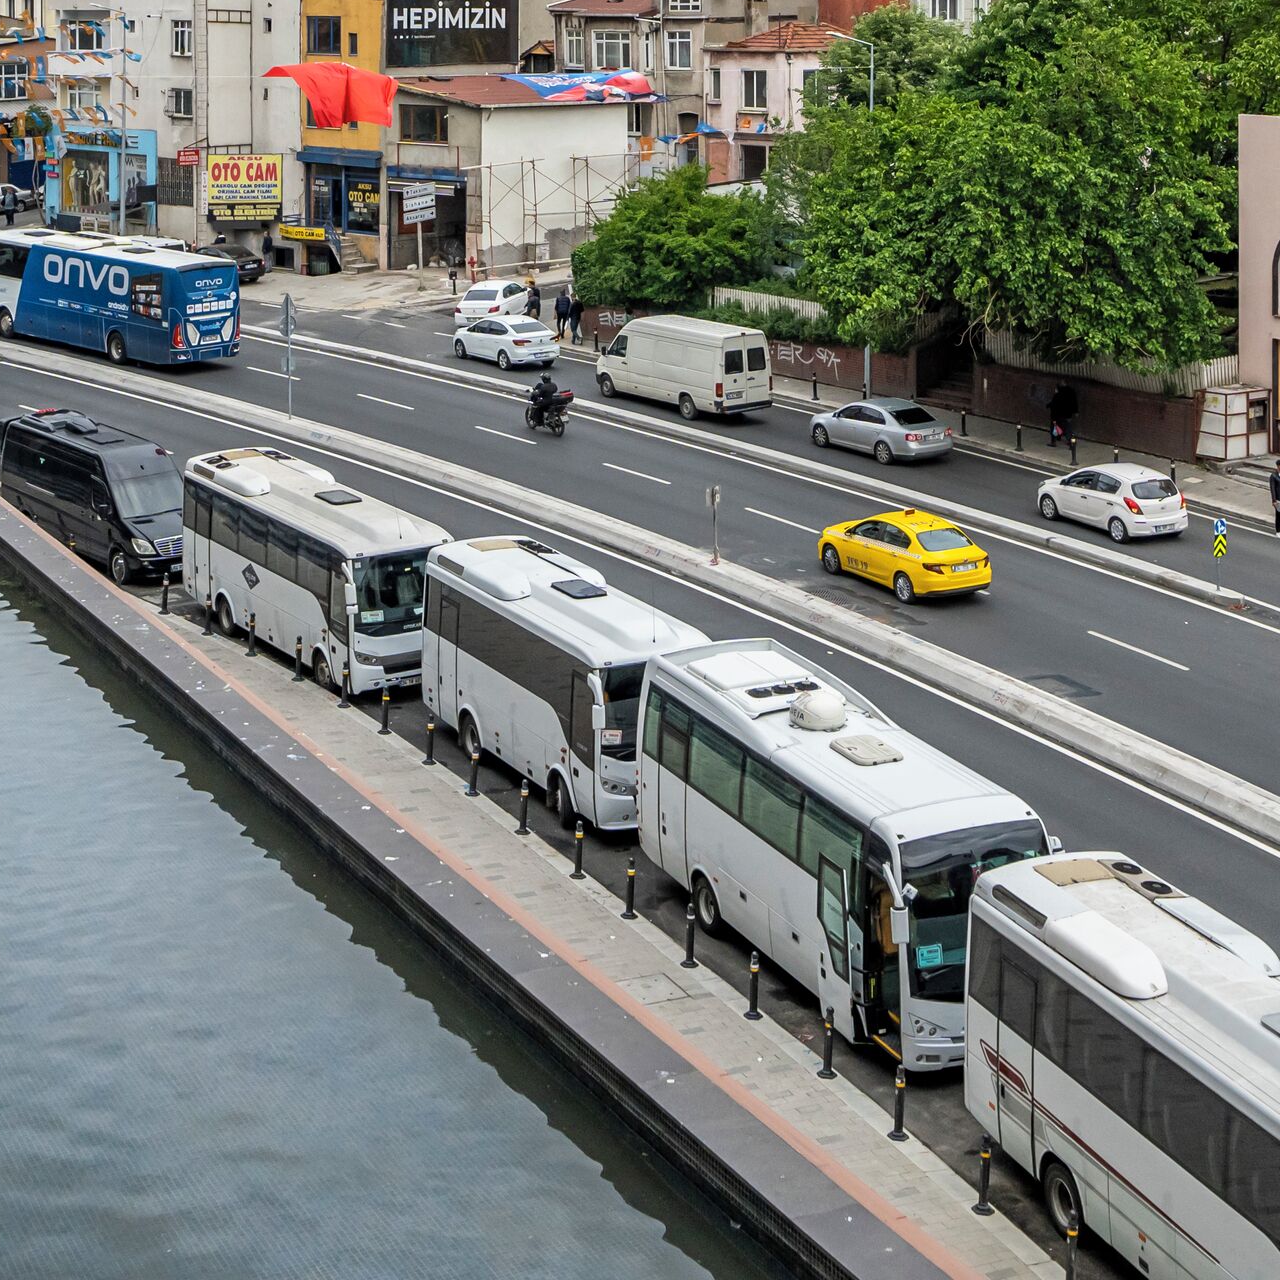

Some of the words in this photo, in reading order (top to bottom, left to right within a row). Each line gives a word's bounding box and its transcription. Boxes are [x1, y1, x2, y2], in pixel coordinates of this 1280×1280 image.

[393, 1, 506, 30] HEPİMİZİN
[211, 162, 241, 182] OTO
[246, 162, 278, 182] CAM
[348, 191, 363, 201] OTO
[365, 192, 380, 203] CAM
